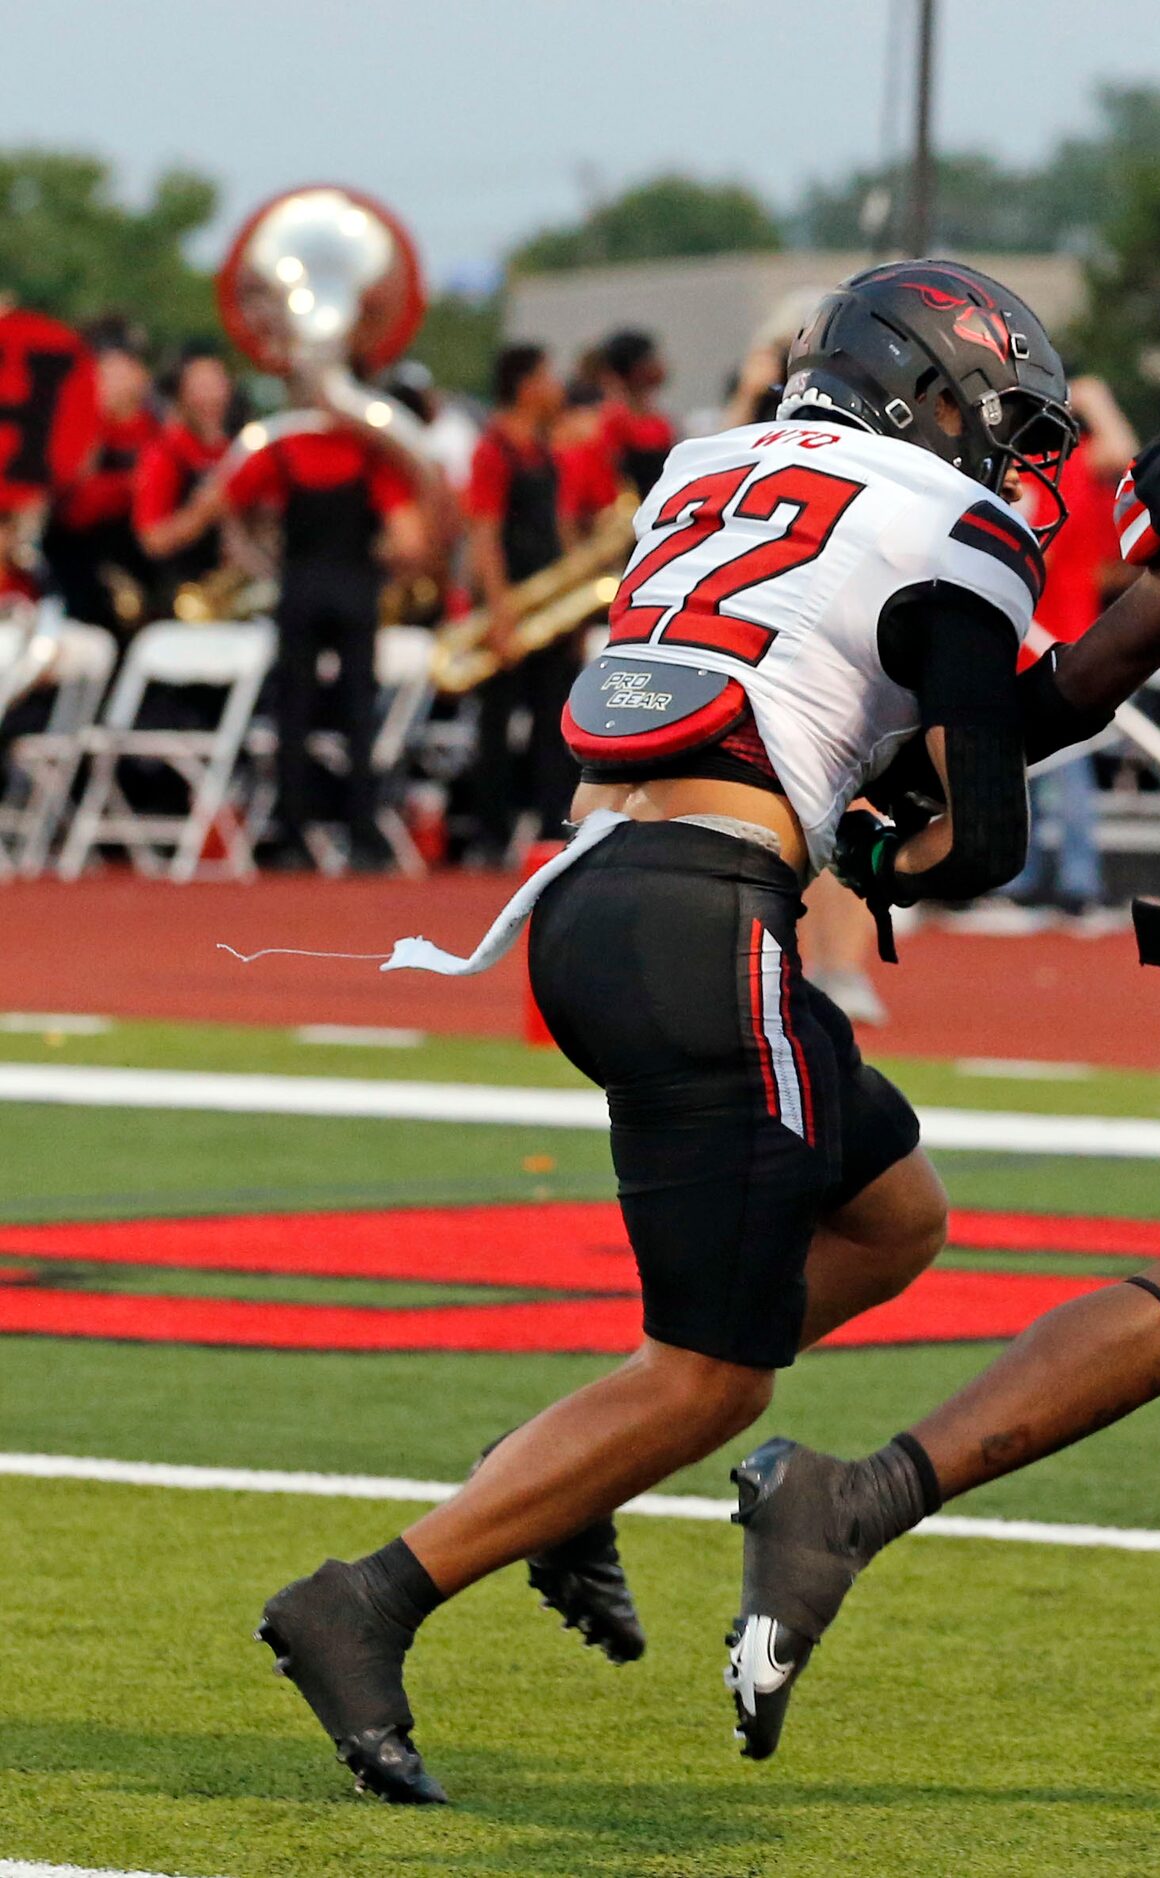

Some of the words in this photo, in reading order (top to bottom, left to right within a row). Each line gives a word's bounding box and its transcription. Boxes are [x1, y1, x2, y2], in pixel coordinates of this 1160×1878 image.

[603, 461, 868, 668] 22
[600, 671, 652, 691] PRO
[606, 689, 672, 712] GEAR
